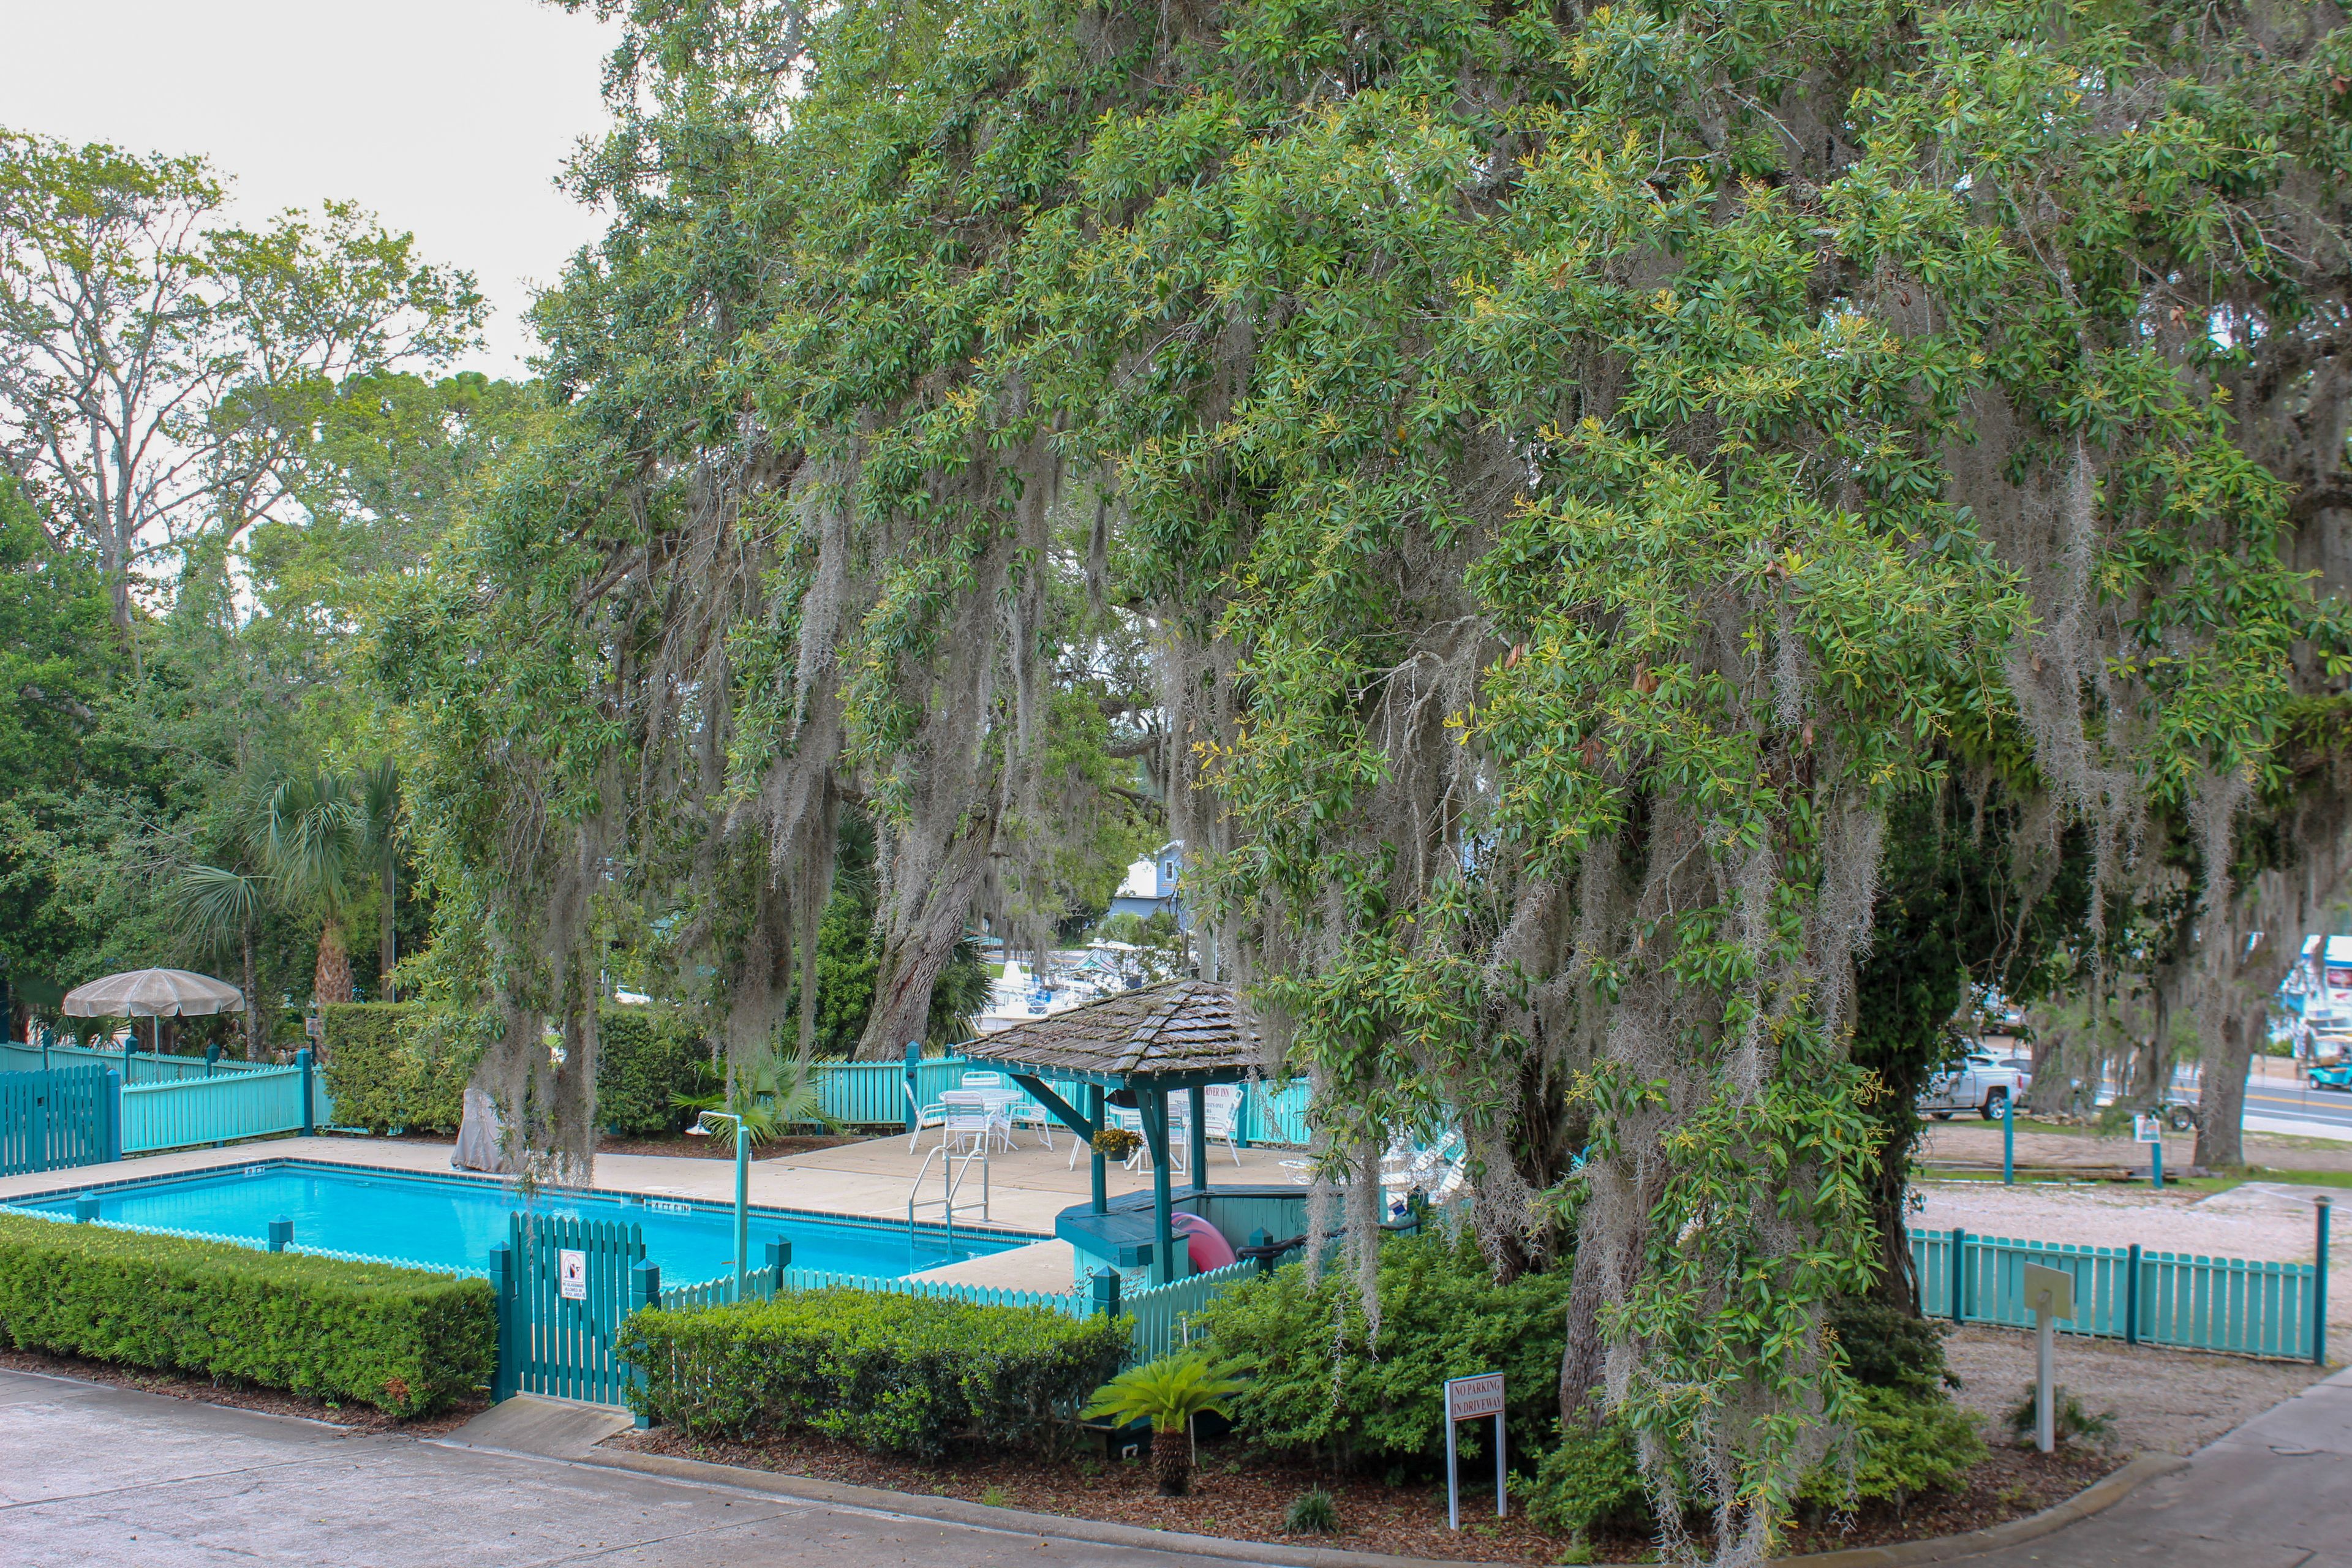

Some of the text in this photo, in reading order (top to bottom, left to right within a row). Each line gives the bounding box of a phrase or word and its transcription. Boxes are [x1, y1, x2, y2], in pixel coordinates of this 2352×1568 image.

[1205, 1087, 1230, 1097] RIVER INN
[1455, 1379, 1500, 1397] NO PARKING
[1454, 1396, 1501, 1415] IN DRIVEWAY
